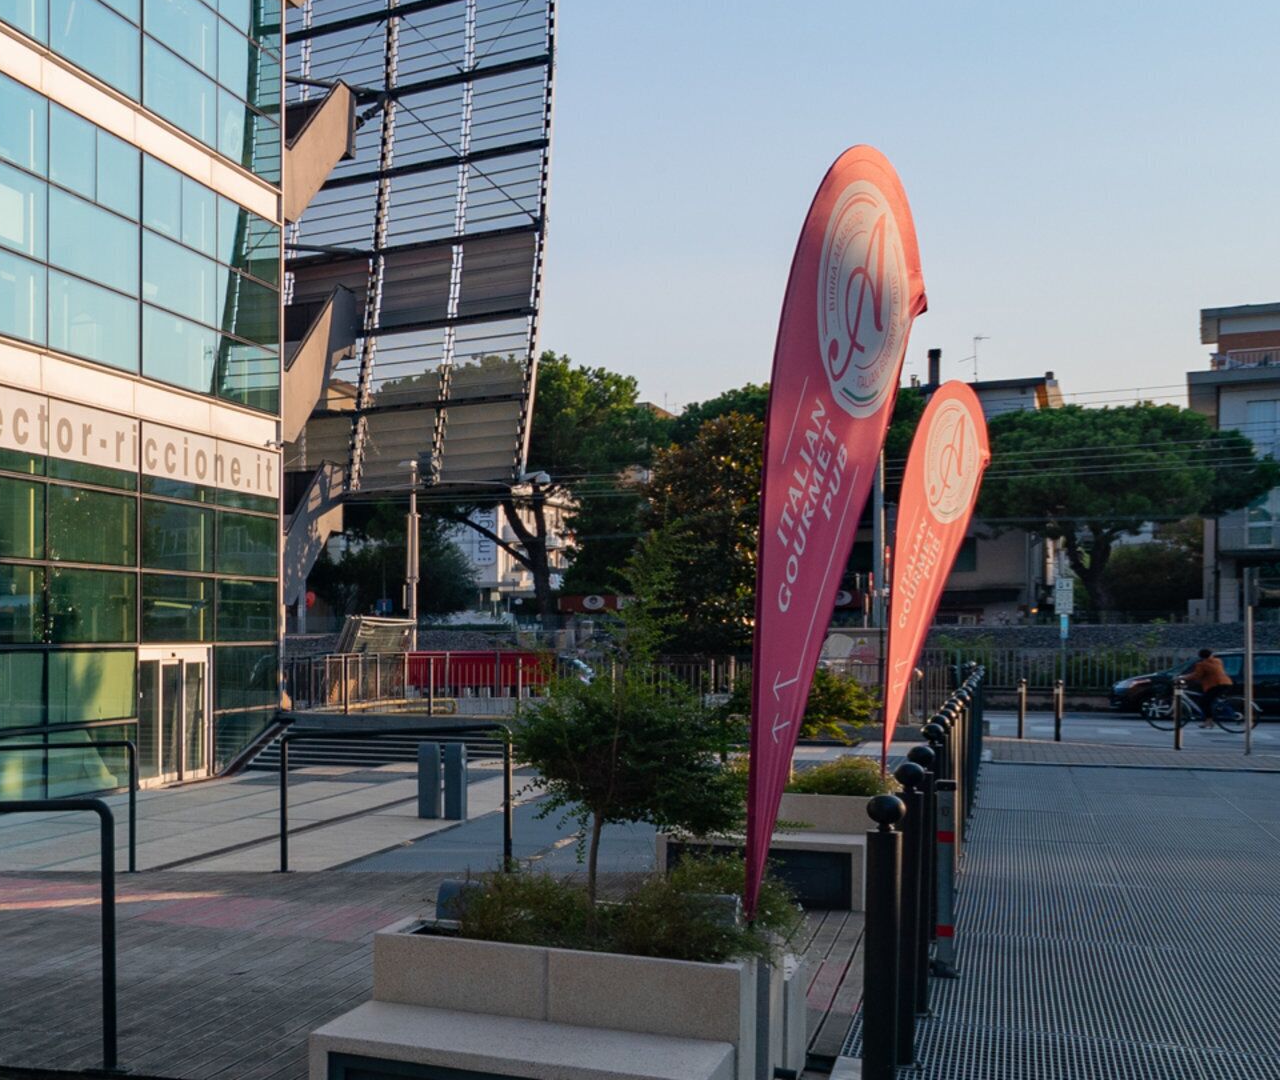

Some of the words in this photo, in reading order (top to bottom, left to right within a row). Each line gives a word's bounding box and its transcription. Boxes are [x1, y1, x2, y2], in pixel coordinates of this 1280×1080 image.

[777, 397, 827, 548] ITALIAN
[778, 419, 838, 613] GOURMET
[821, 443, 849, 521] PUB
[899, 516, 928, 595] ITALIAN
[899, 526, 934, 629] GOURMET
[924, 537, 941, 579] PUB
